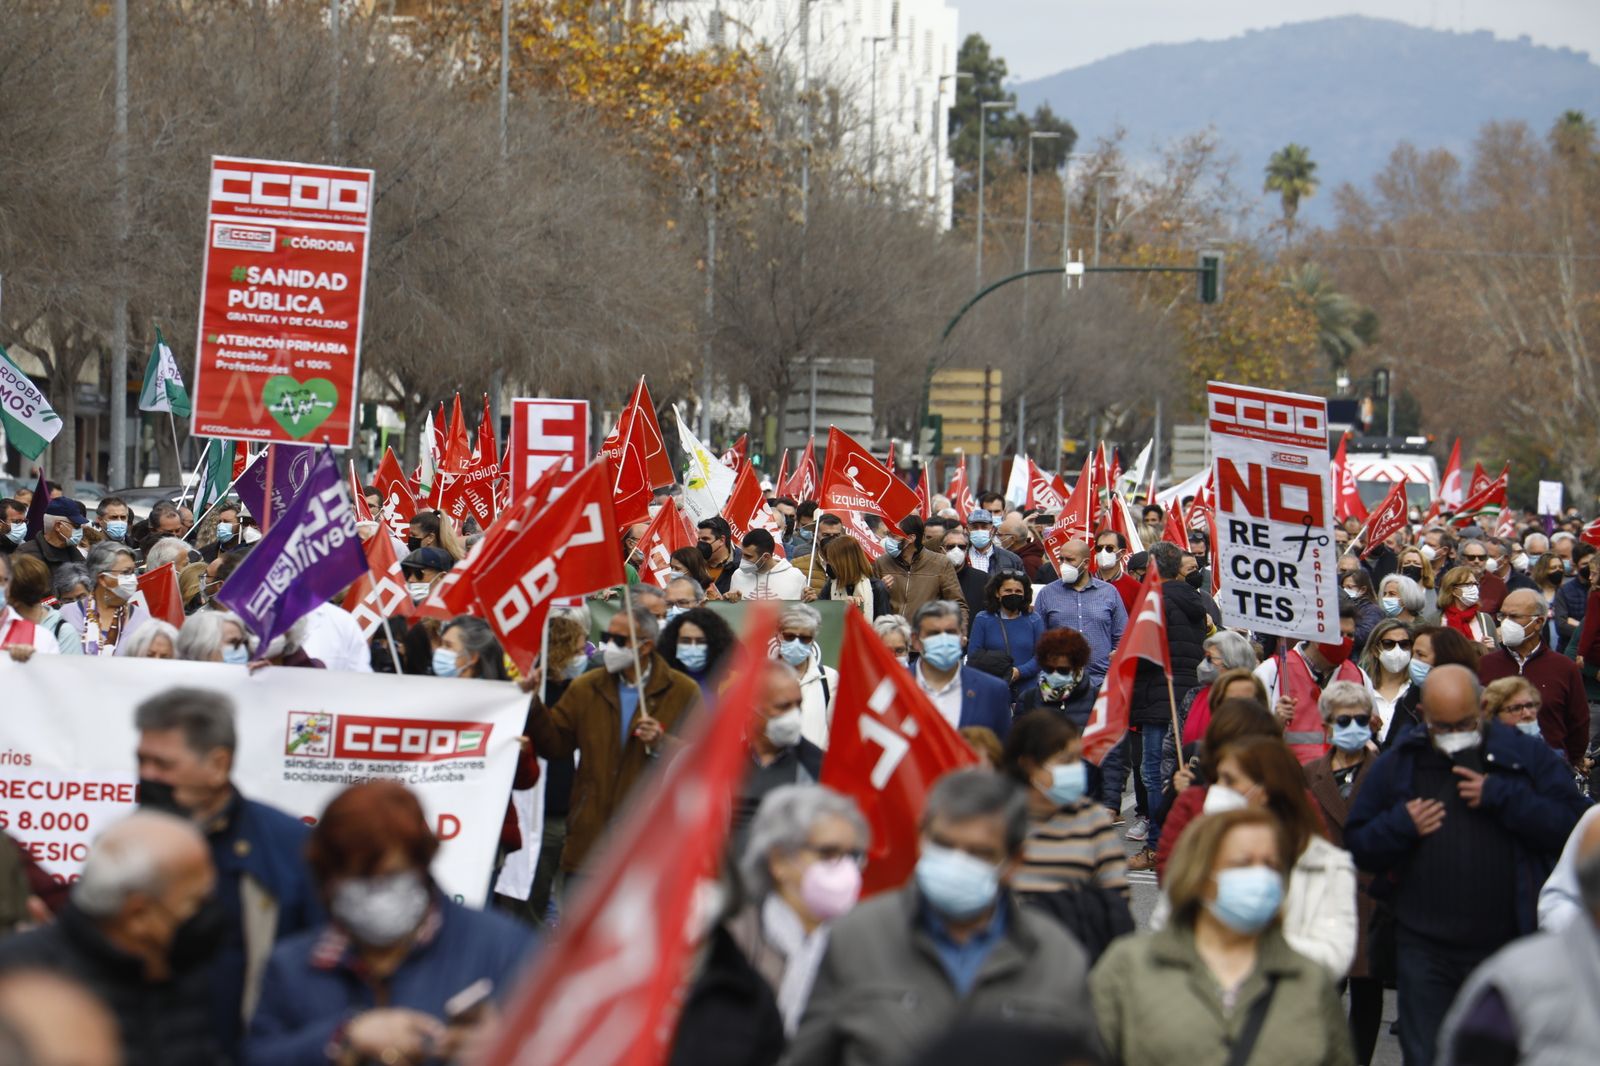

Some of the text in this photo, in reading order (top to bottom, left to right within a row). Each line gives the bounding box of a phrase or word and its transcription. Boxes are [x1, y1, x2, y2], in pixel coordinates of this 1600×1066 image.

[210, 170, 369, 213] CCOO
[282, 236, 355, 253] #CÓRDOBA
[231, 266, 348, 291] #SANIDAD
[228, 286, 324, 314] PÚBLICA
[226, 312, 348, 330] GRATUITA Y DE CALIDAD
[286, 340, 349, 355] PRIMARIA
[1208, 392, 1327, 439] CCOO
[1217, 457, 1324, 528] NO
[1229, 519, 1271, 549] RE
[1231, 554, 1300, 589] COR
[1232, 588, 1295, 622] TES
[1312, 548, 1325, 633] SANIDAD
[344, 724, 457, 755] CCOO
[284, 758, 345, 772] sindicato
[348, 760, 364, 772] de
[367, 762, 418, 774] sanidad
[18, 811, 89, 832] 8.000
